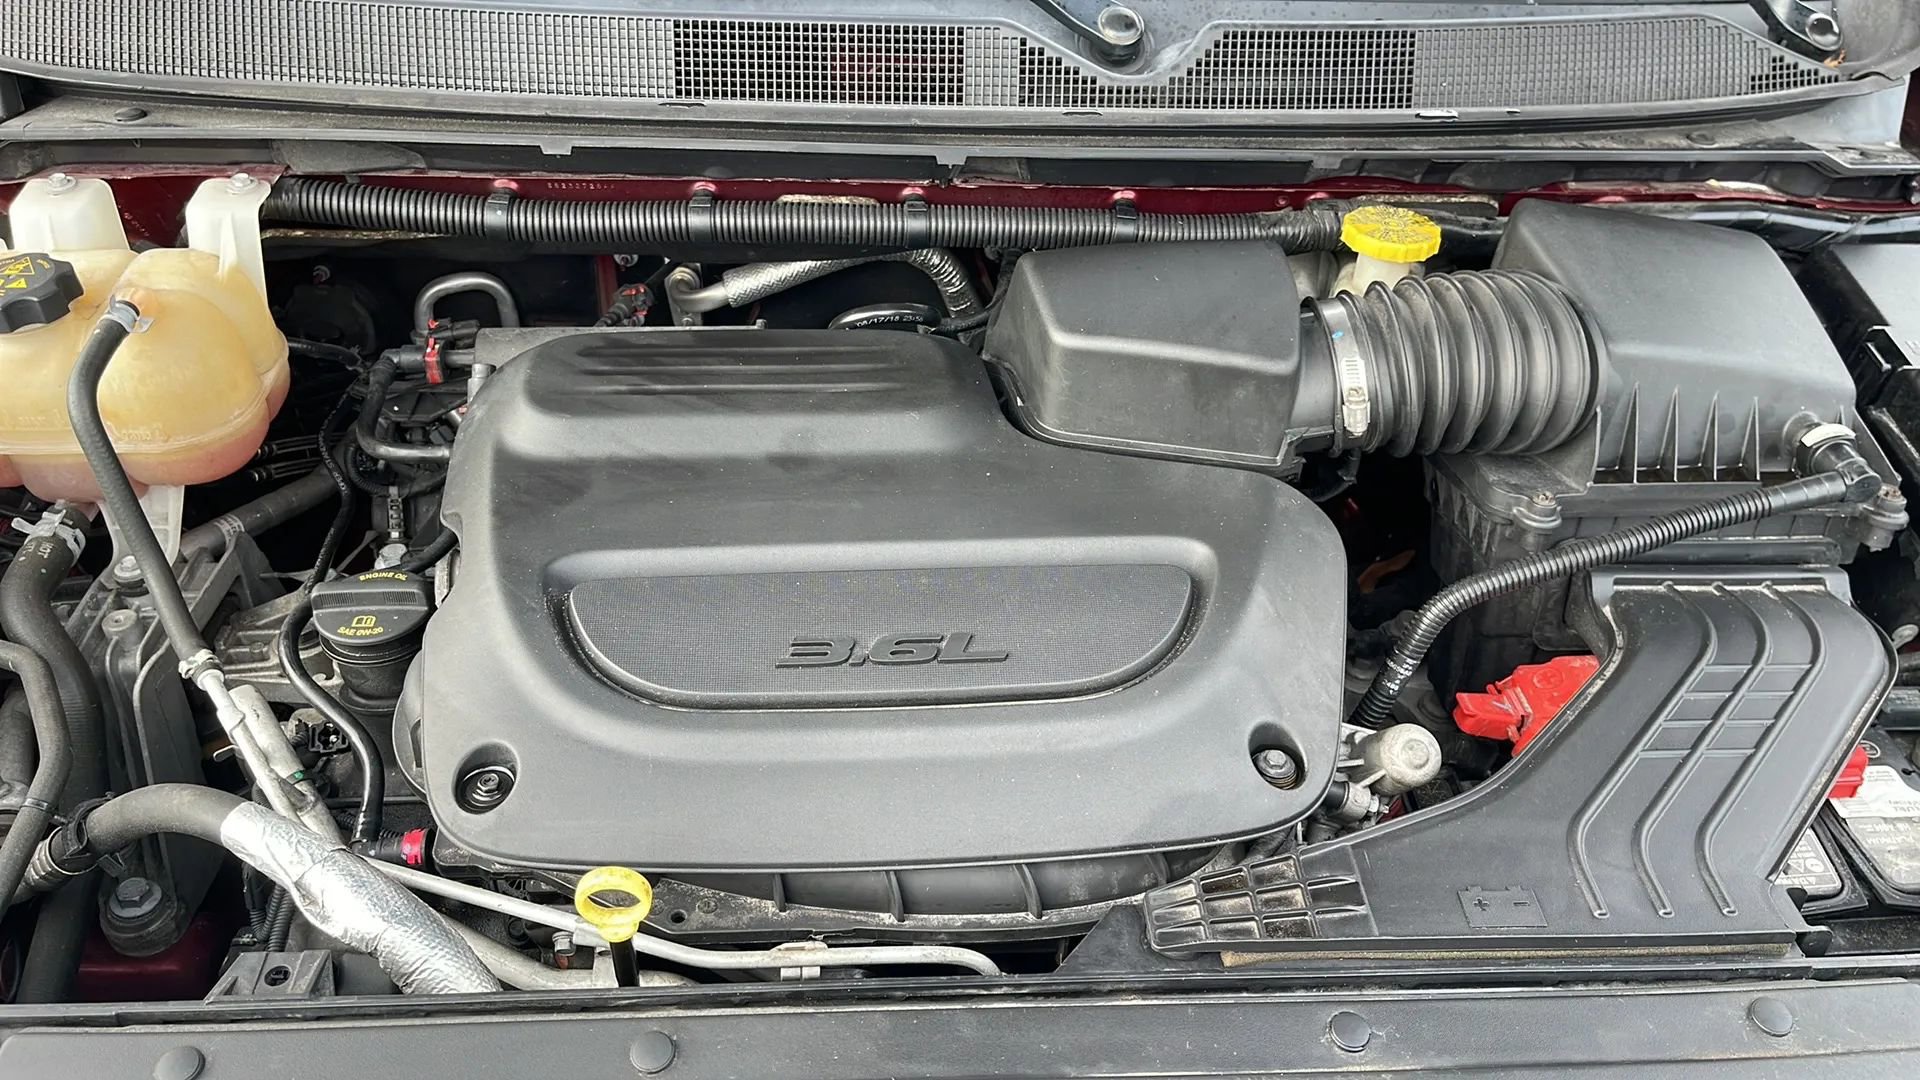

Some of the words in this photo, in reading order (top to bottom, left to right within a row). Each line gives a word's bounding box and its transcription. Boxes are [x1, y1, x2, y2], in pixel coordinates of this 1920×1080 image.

[359, 572, 394, 581] ENGINE
[394, 573, 407, 581] OIL
[337, 626, 356, 636] SAE
[775, 630, 1009, 668] 3.6L
